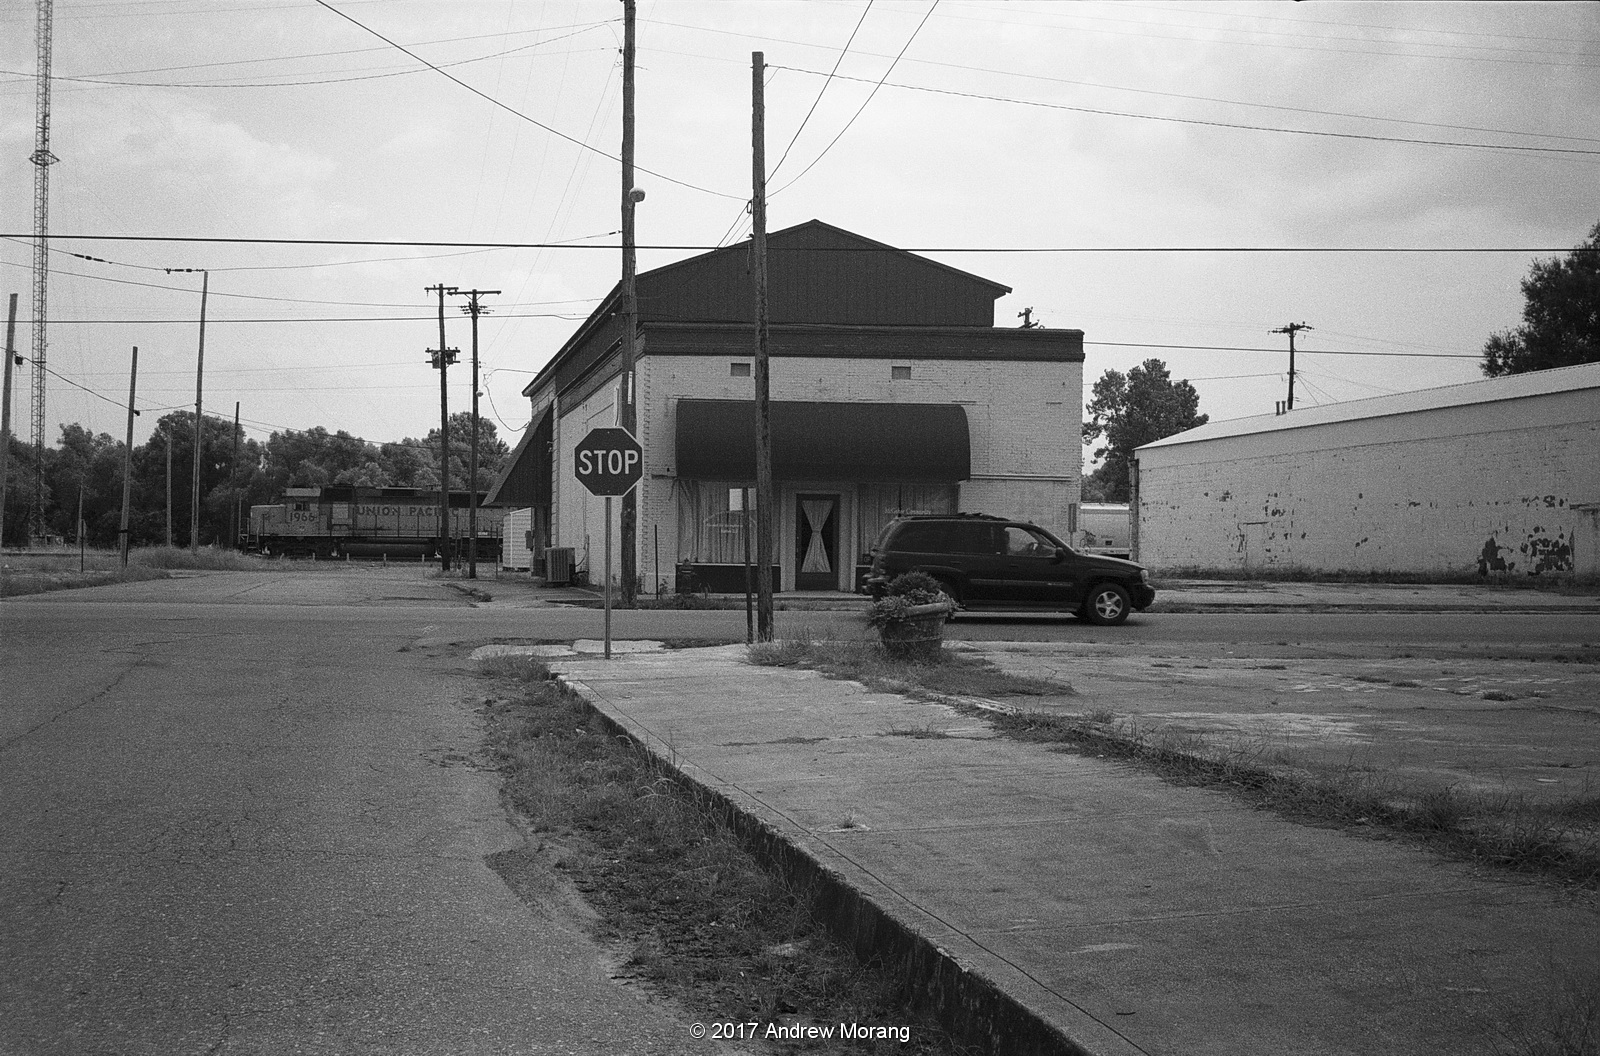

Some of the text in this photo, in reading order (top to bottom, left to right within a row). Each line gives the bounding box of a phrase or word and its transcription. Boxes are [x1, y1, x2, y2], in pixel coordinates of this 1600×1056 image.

[578, 449, 639, 475] STOP
[289, 512, 315, 522] 1966
[357, 505, 460, 517] UNION PACIC
